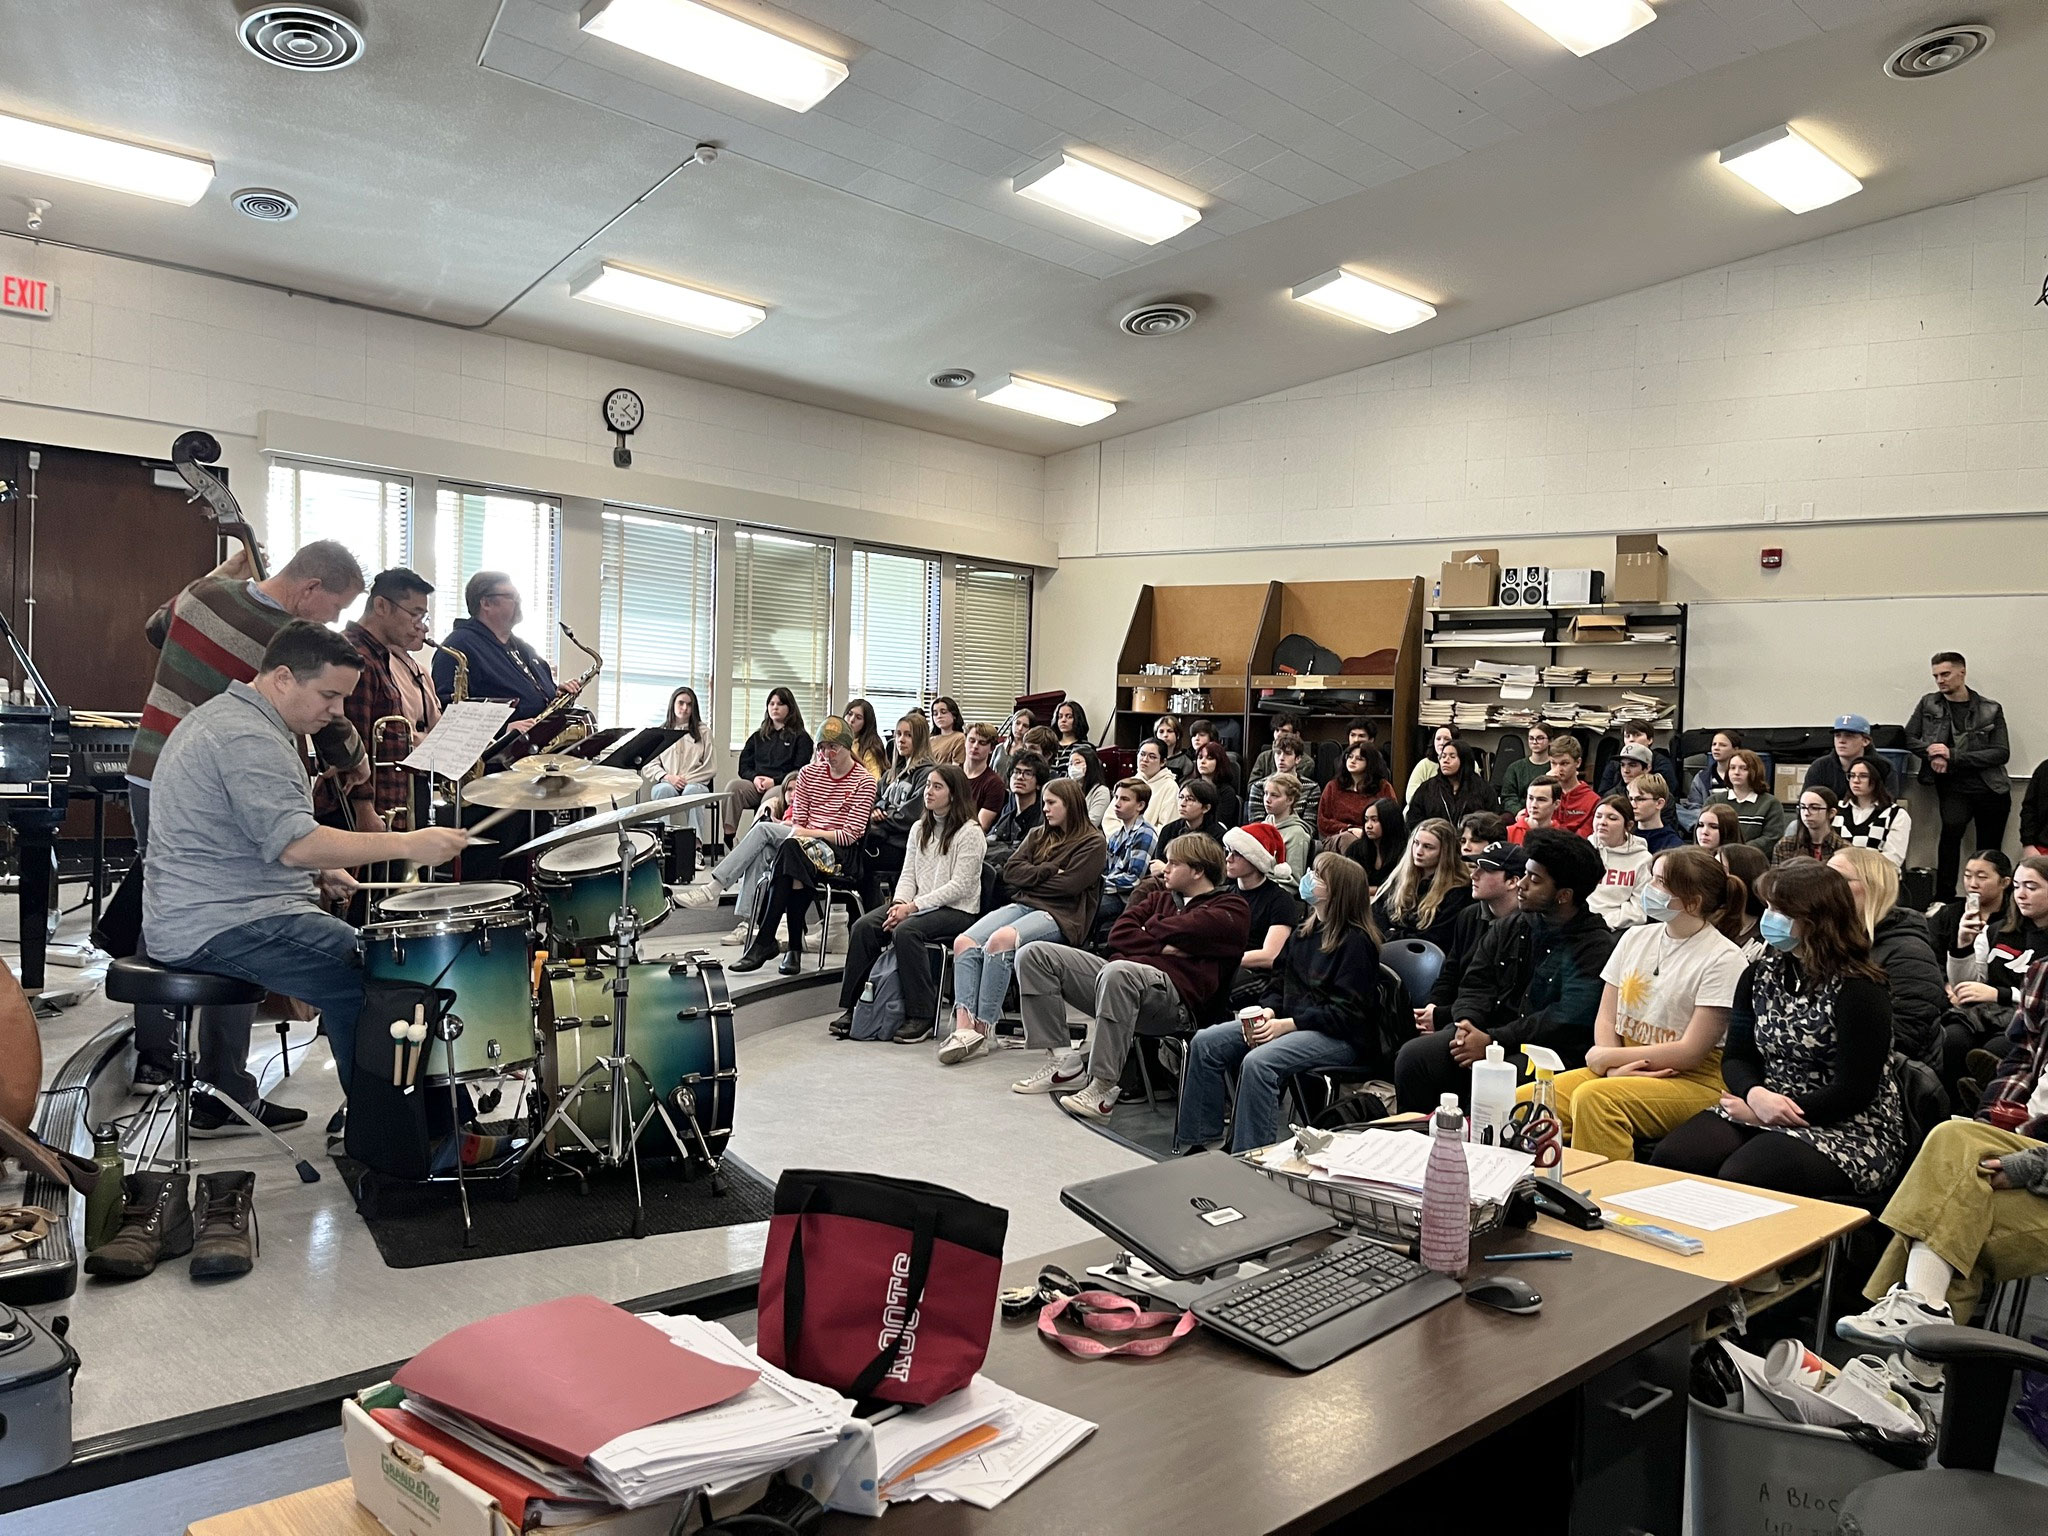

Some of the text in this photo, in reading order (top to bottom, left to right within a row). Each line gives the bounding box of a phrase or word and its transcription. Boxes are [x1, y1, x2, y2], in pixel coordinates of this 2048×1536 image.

[4, 276, 48, 311] EXIT
[1841, 715, 1852, 725] T
[102, 761, 128, 773] YAMAH
[1600, 868, 1636, 887] EM
[1760, 1482, 1839, 1514] A BLOC
